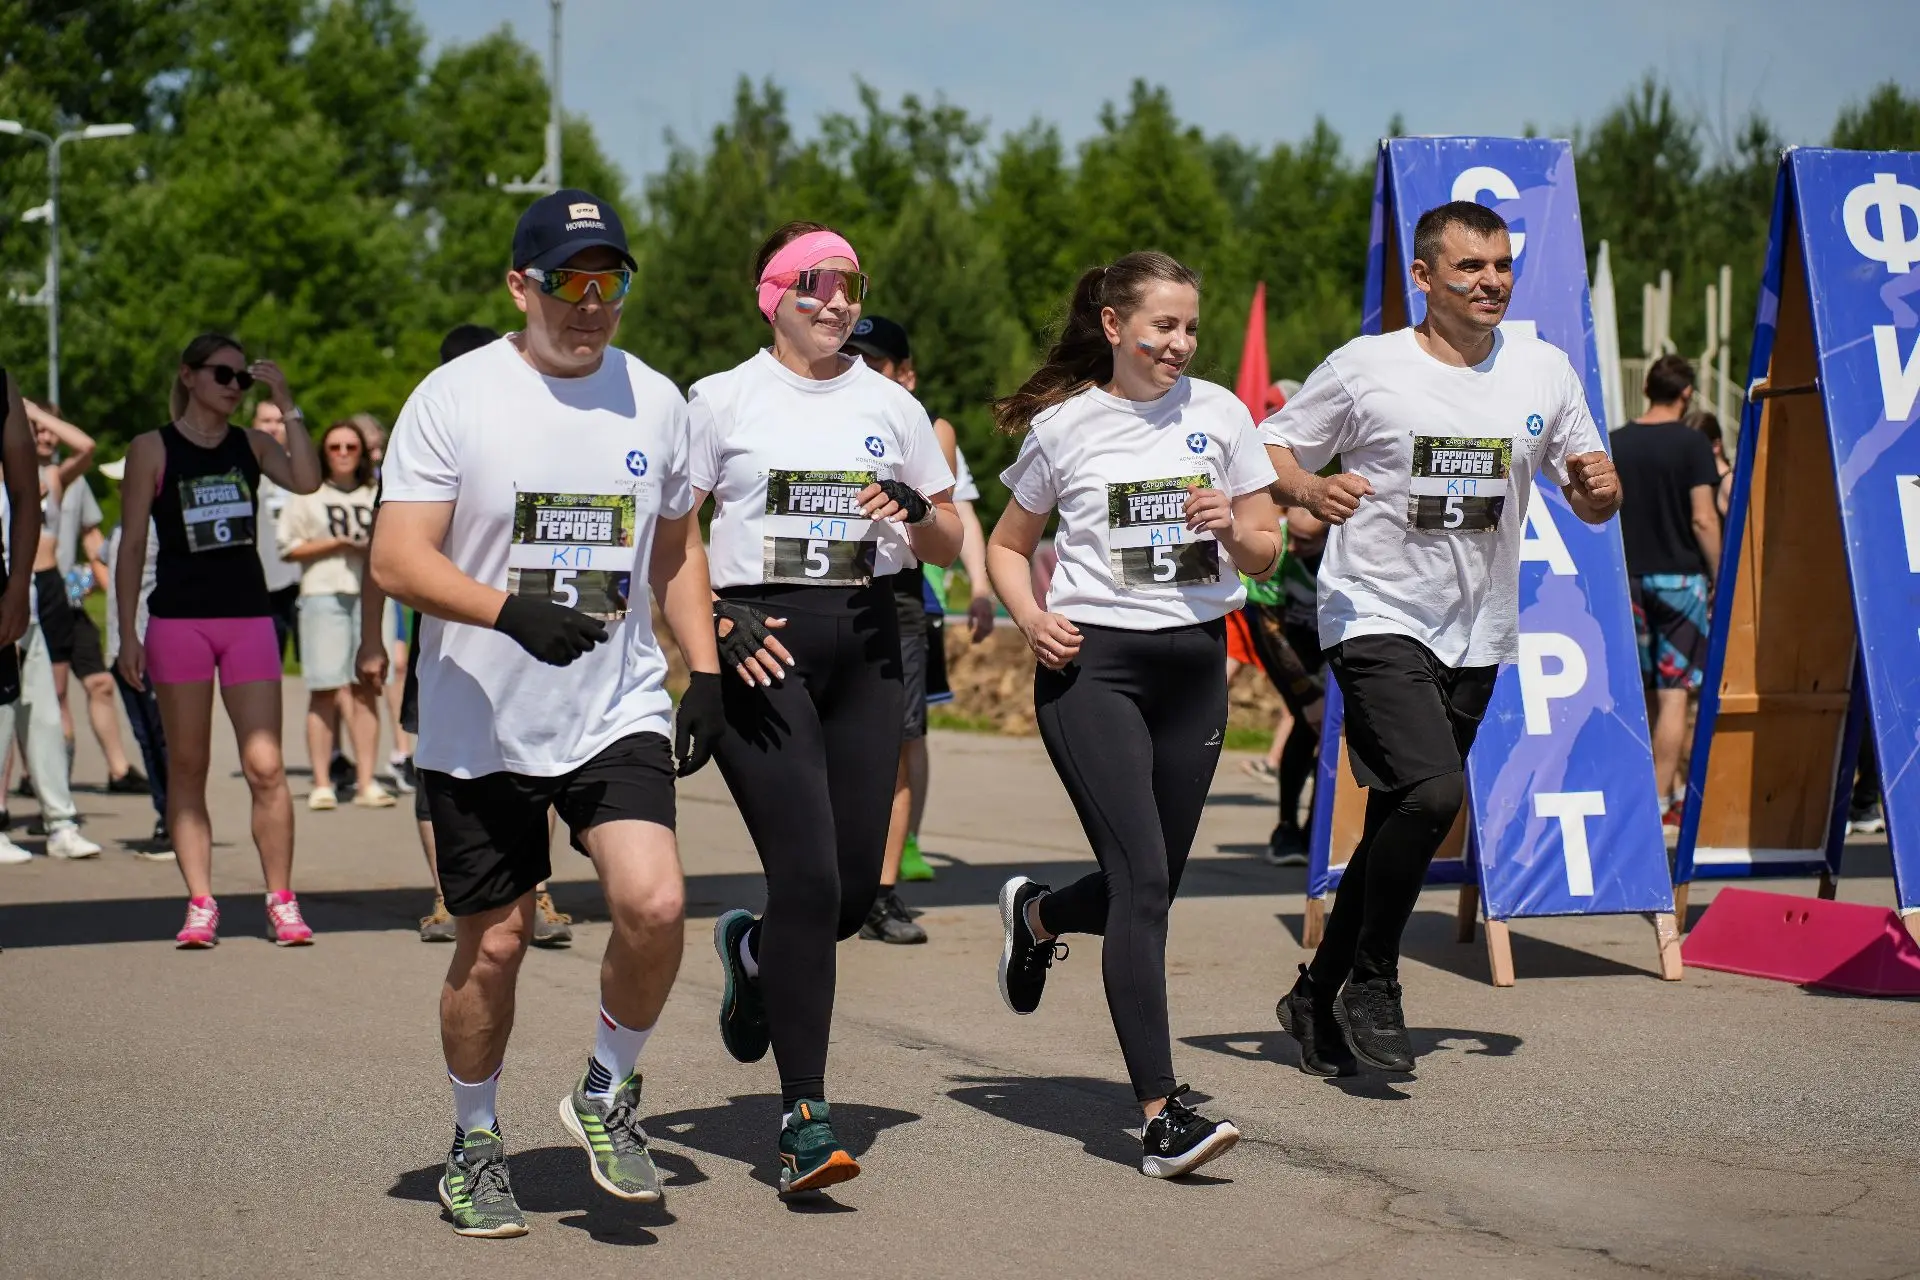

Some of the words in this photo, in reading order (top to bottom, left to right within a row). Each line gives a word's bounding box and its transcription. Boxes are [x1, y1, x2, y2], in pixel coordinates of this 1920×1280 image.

[1431, 450, 1494, 461] ТЕРРИТОРИЯ
[1431, 460, 1494, 475] ГЕРОЕВ
[1447, 479, 1477, 496] КП
[536, 509, 613, 523] ТЕРРИТОРИЯ
[1443, 496, 1465, 529] 5
[214, 518, 232, 542] 6
[535, 520, 612, 541] ГЕРОЕВ
[810, 519, 846, 540] КП
[1150, 526, 1181, 545] КП
[552, 546, 592, 567] КП
[805, 540, 830, 578] 5
[1153, 545, 1177, 582] 5
[552, 570, 579, 608] 5
